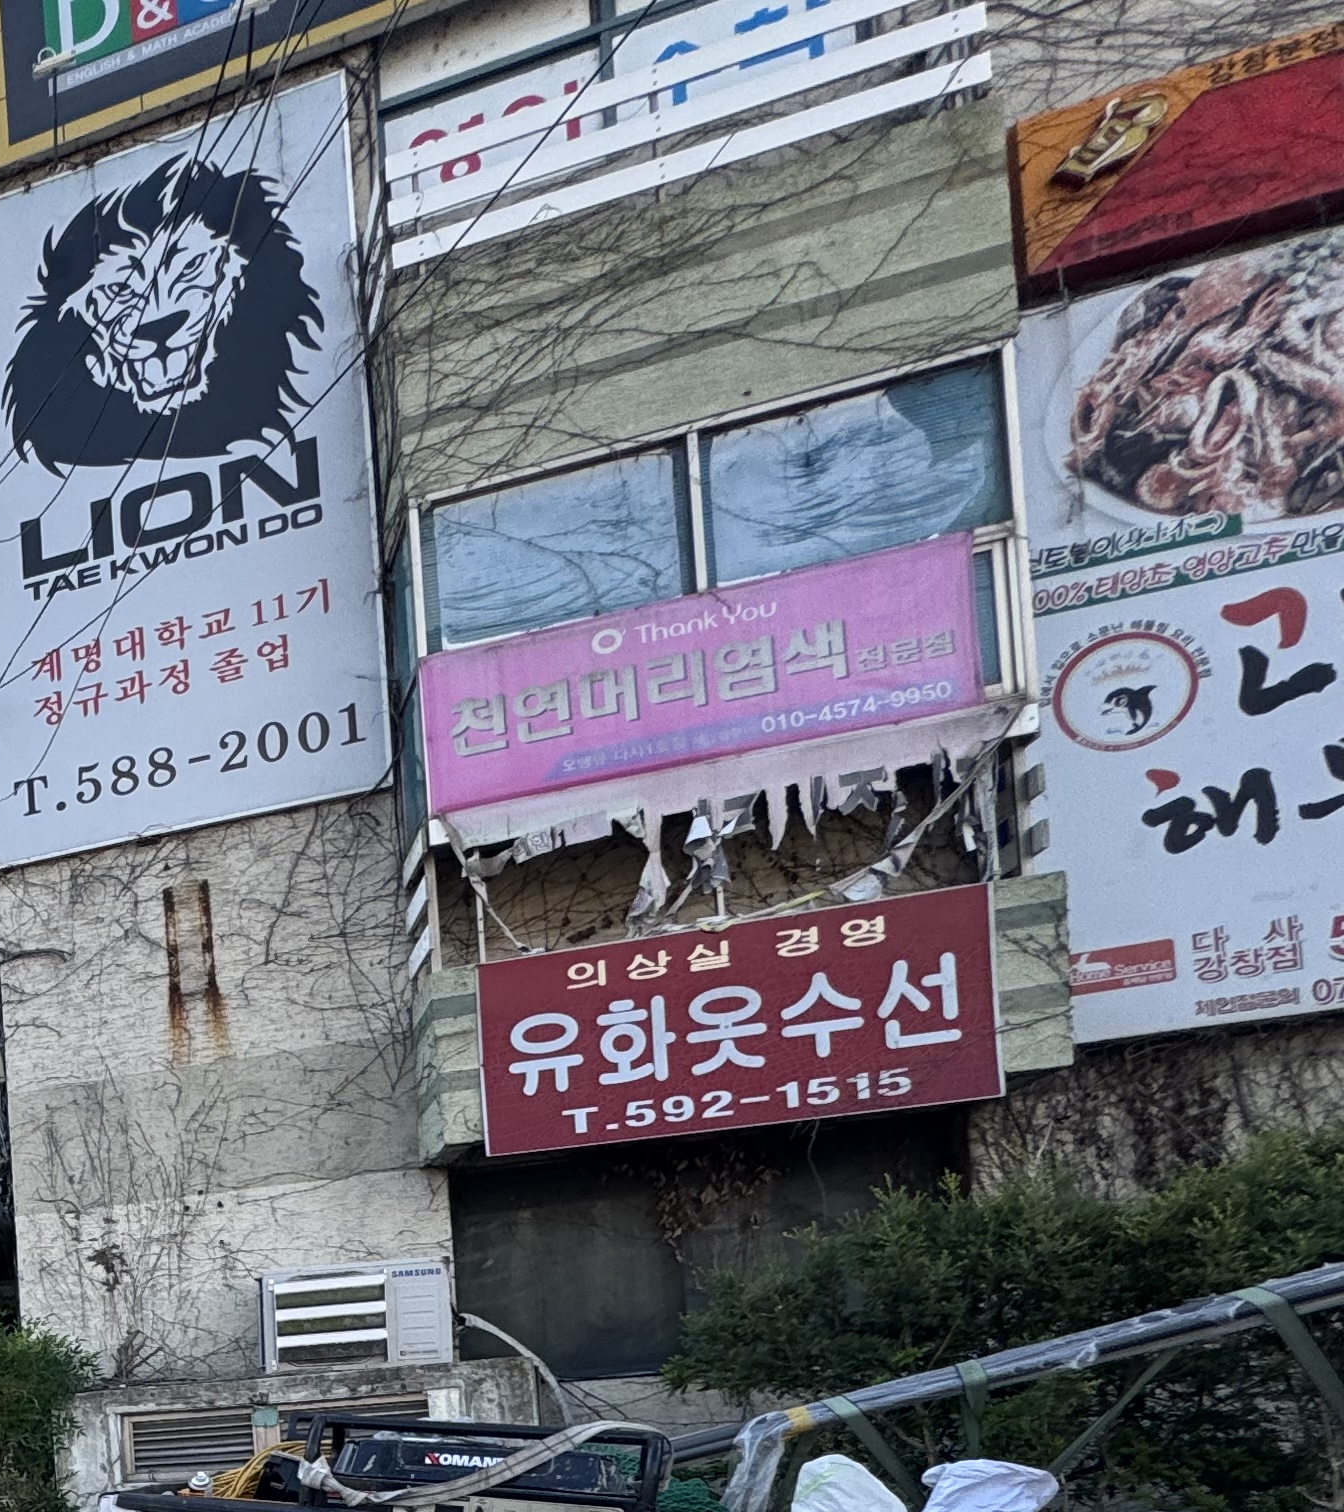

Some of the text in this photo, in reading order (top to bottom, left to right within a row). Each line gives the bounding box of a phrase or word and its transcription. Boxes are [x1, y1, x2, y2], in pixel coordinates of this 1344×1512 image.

[66, 57, 121, 87] ENGLISH
[127, 50, 136, 63] &
[141, 35, 178, 58] MATH
[20, 436, 321, 580] LION
[23, 503, 323, 601] TAE KWON DO
[1033, 582, 1088, 612] 00%
[1095, 563, 1175, 596] 태양초
[31, 578, 331, 683] 계명대학교 11기
[633, 614, 718, 646] Thank
[722, 600, 777, 628] You
[1220, 586, 1344, 717] 고
[33, 634, 290, 726] 정규과정 졸업
[451, 619, 850, 758] 천연머리염색
[761, 681, 953, 734] 010-4574-9950
[14, 703, 367, 817] T.588-2001
[566, 915, 888, 991] 의상실 경영
[1069, 968, 1111, 984] Home
[1113, 960, 1172, 976] Service
[1193, 943, 1303, 982] 강창점
[508, 951, 962, 1097] 유화옷수선
[562, 1066, 913, 1135] T.592-1515
[392, 1267, 442, 1278] SAMSUNG
